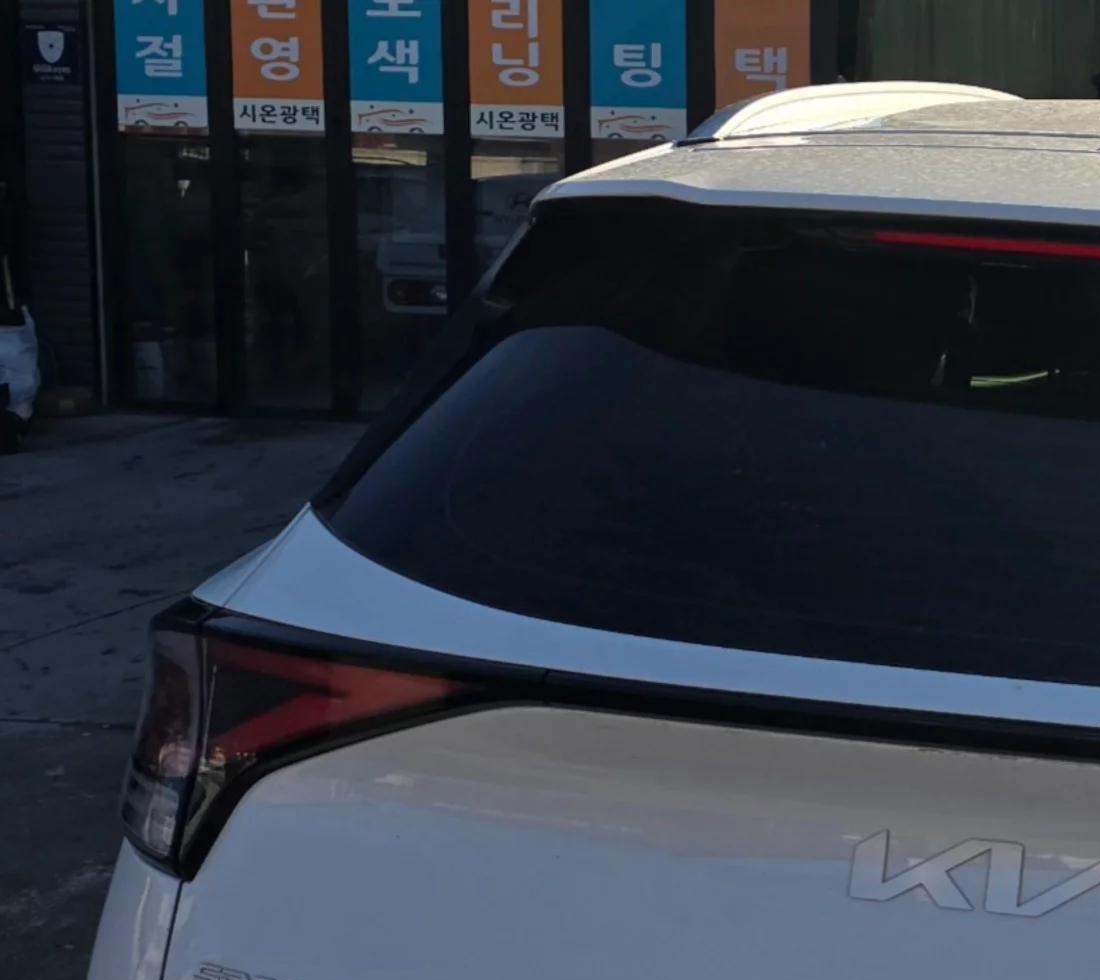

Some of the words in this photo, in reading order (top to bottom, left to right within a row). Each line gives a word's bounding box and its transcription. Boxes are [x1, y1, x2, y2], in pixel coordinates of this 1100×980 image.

[612, 42, 663, 88] 팅
[734, 47, 788, 90] 택
[239, 104, 320, 125] 시온광택
[475, 110, 559, 131] 시온광택
